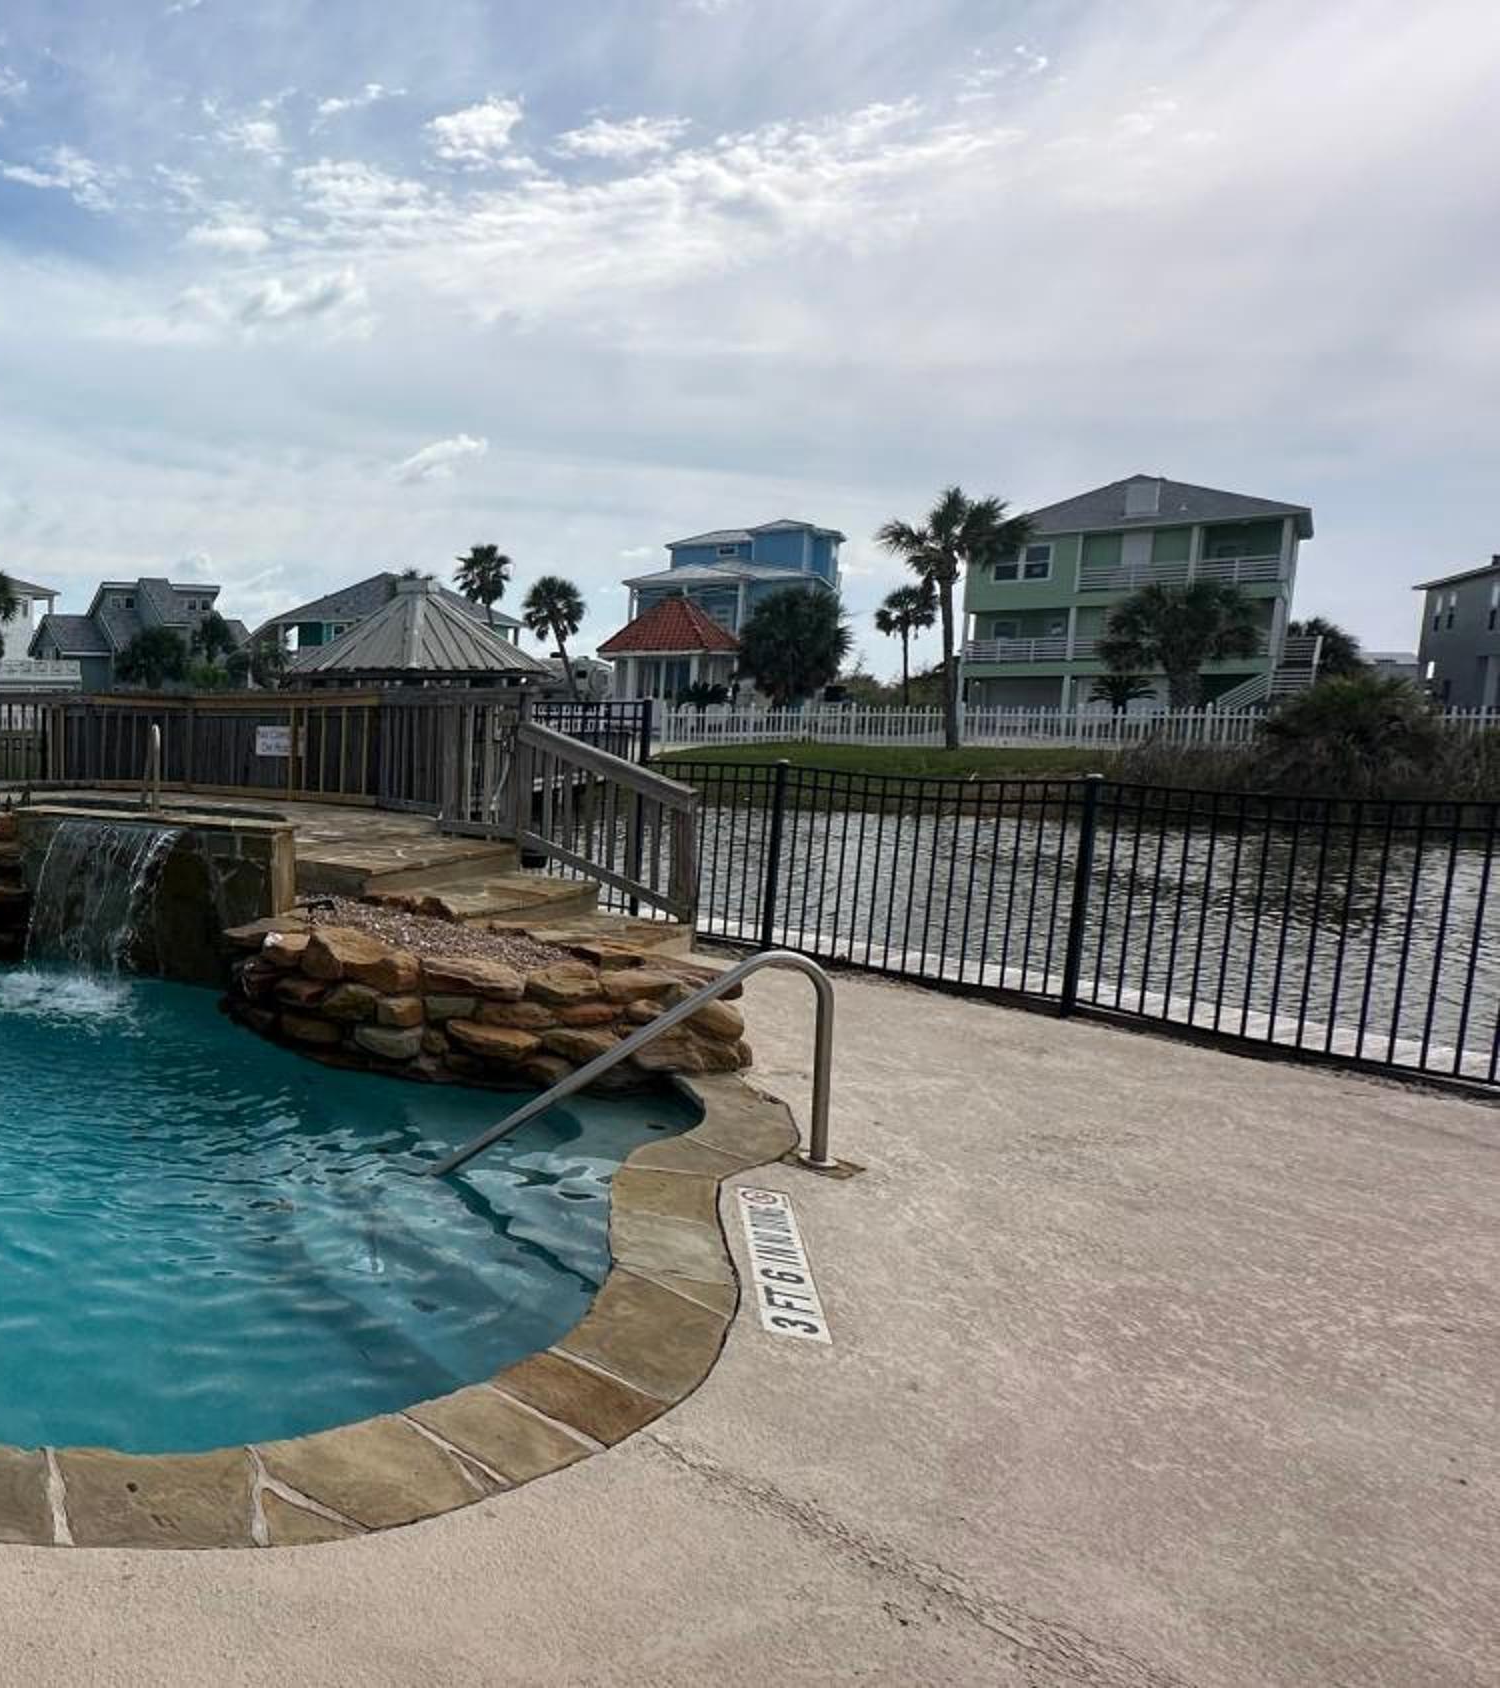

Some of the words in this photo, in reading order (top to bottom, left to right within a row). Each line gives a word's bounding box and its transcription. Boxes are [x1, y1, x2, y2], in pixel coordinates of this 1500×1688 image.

[754, 1243, 801, 1266] IN
[760, 1267, 805, 1284] 6
[763, 1285, 816, 1314] FT
[770, 1316, 819, 1334] 3
